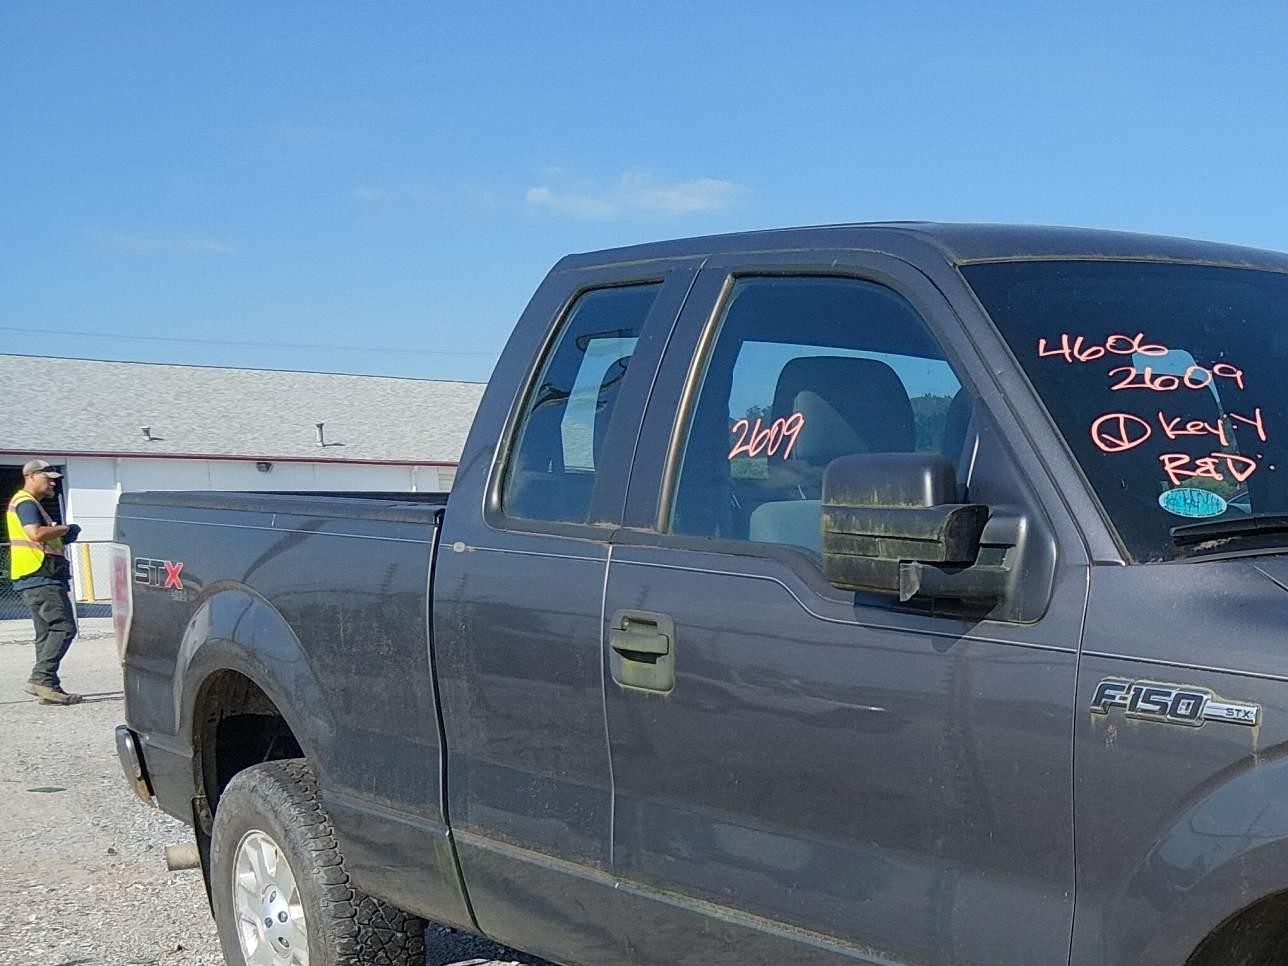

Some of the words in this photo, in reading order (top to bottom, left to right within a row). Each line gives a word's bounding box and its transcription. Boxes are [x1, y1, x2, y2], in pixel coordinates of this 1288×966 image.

[1038, 333, 1168, 362] 4606
[1108, 363, 1243, 390] 2609
[728, 413, 805, 460] 2609
[135, 557, 184, 590] STX
[1090, 677, 1212, 727] F-150
